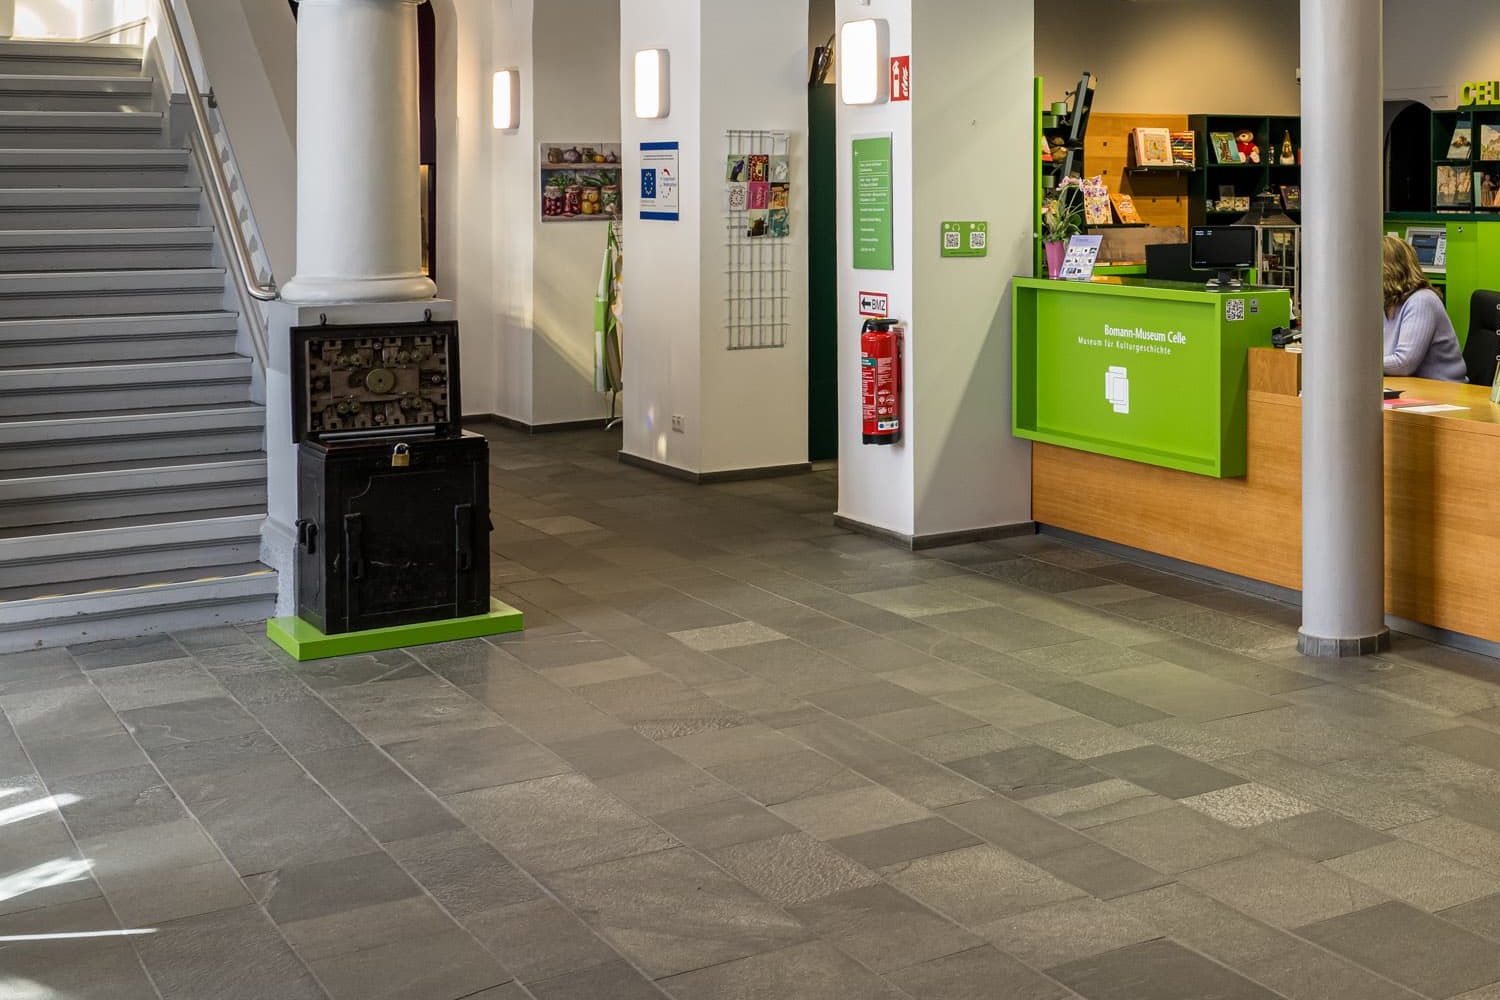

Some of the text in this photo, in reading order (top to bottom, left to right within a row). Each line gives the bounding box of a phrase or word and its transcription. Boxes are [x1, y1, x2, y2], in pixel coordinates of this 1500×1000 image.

[871, 298, 885, 311] BMZ
[1104, 323, 1186, 345] Bomann-Museum Celle
[1078, 335, 1171, 355] Museum für Kulturgeschichte
